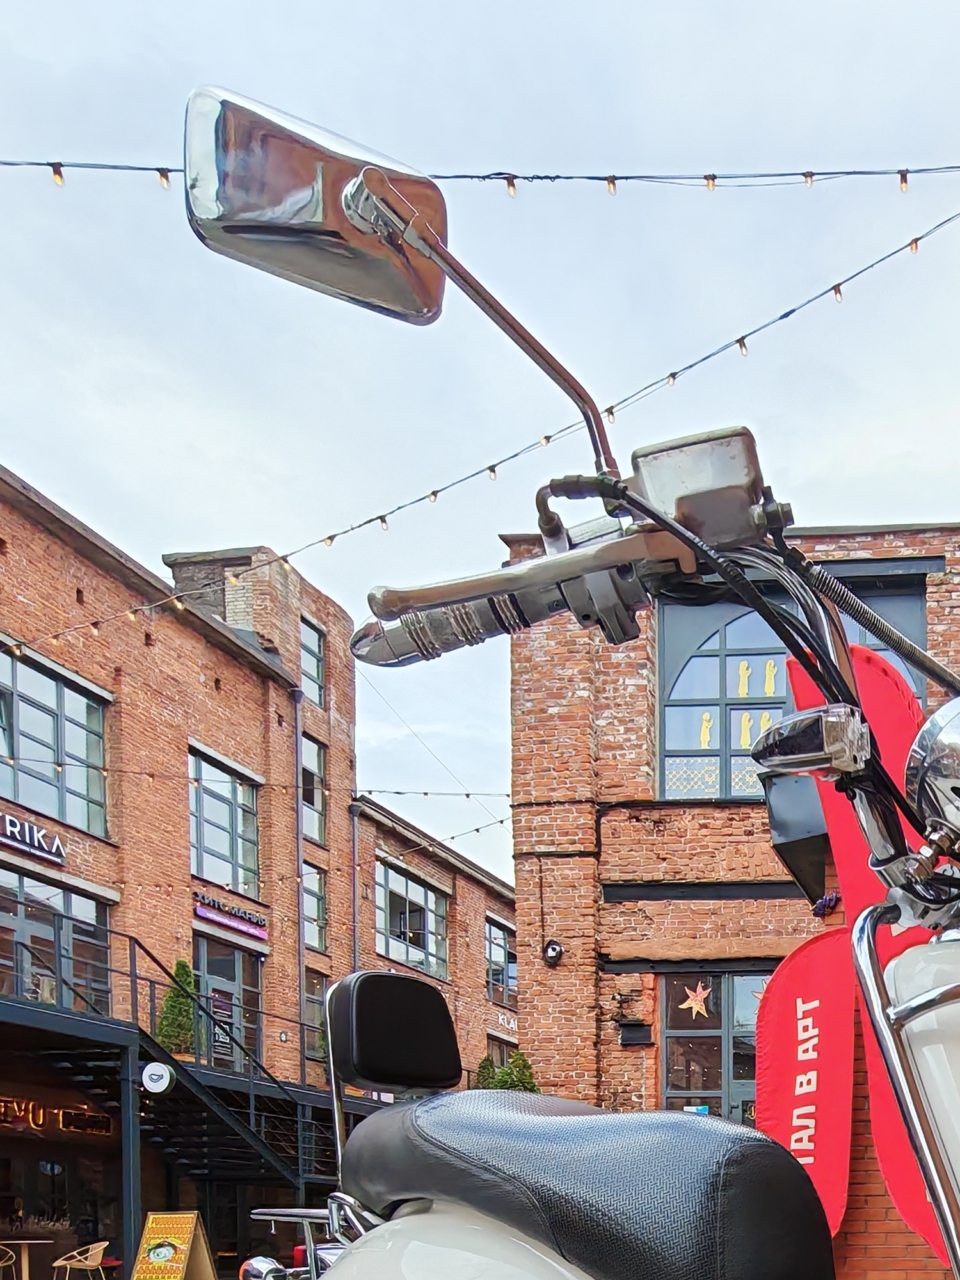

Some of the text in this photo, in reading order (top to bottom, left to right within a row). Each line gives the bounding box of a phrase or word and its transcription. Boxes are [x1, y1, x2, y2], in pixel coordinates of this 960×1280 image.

[0, 812, 66, 857] RIKA
[796, 998, 820, 1061] АРТ
[795, 1070, 817, 1096] В
